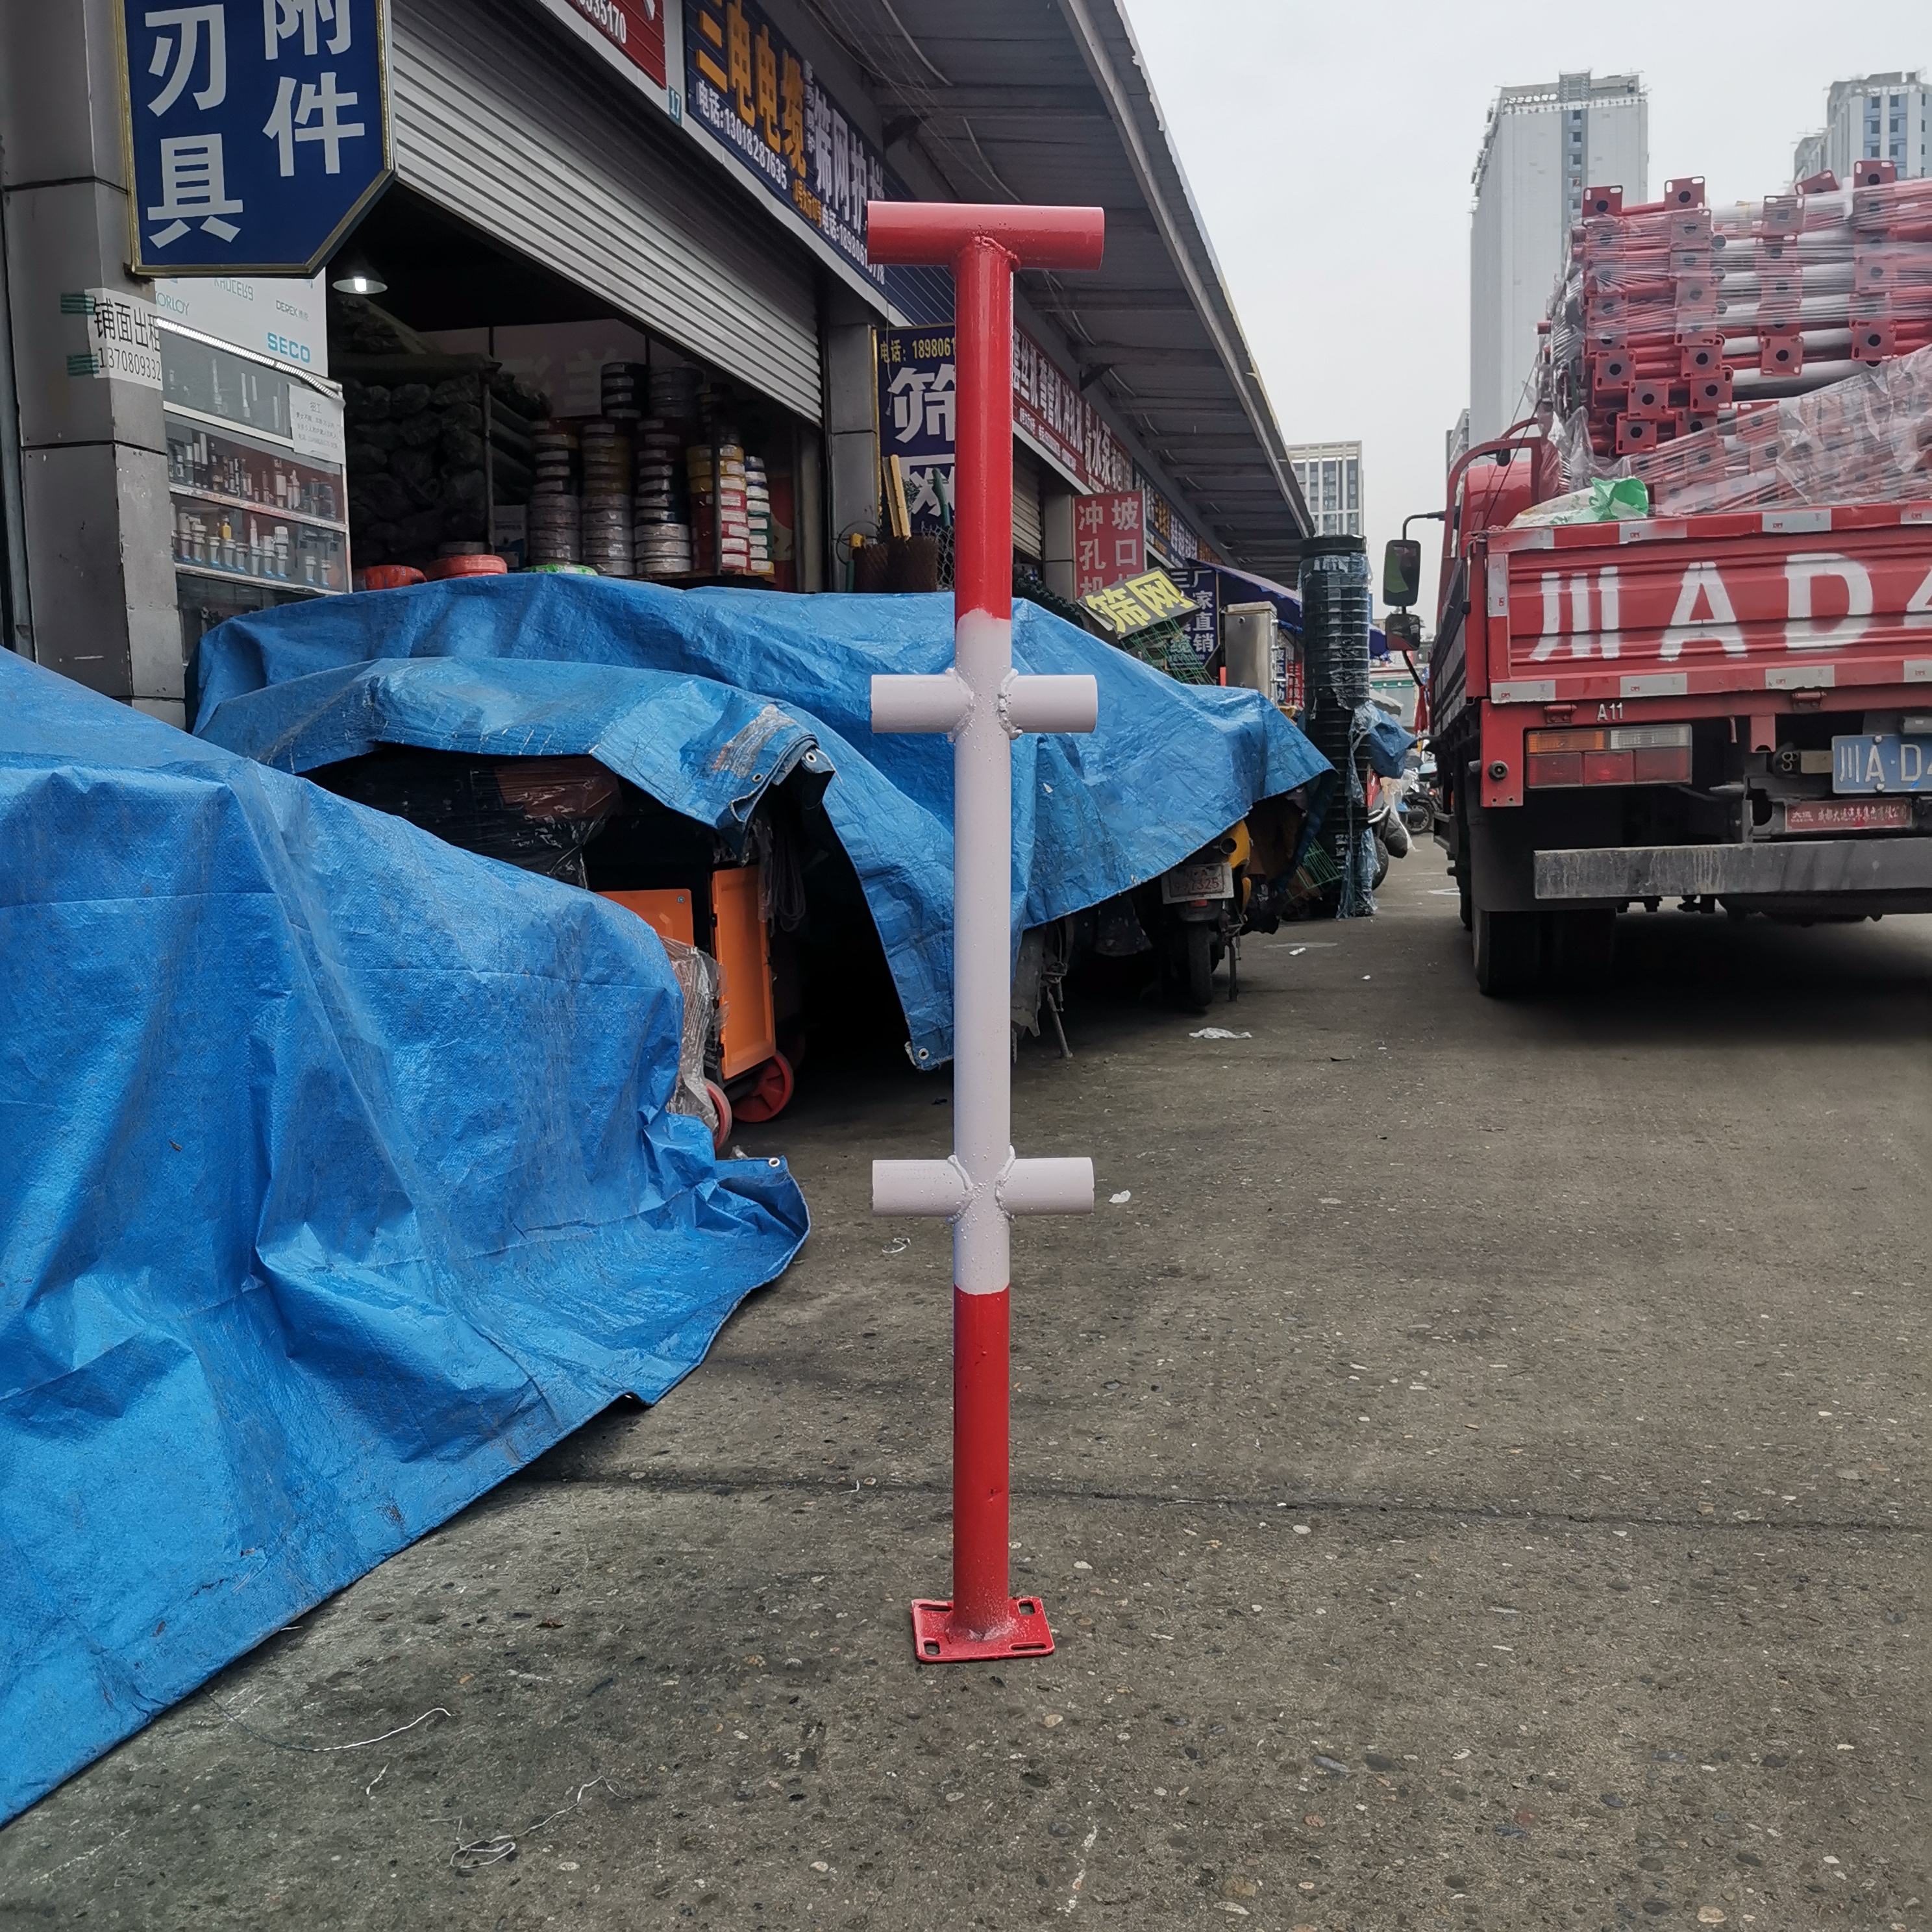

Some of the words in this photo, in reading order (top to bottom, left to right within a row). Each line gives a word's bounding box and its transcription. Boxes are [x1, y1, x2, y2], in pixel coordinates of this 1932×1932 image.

[145, 3, 243, 249] 刃具
[156, 291, 190, 316] ORLOY
[267, 332, 311, 364] SECO
[1111, 497, 1139, 581] 坡口
[1085, 570, 1195, 633] 筛网
[1192, 569, 1215, 652] 厂家直销
[1596, 702, 1624, 722] A11
